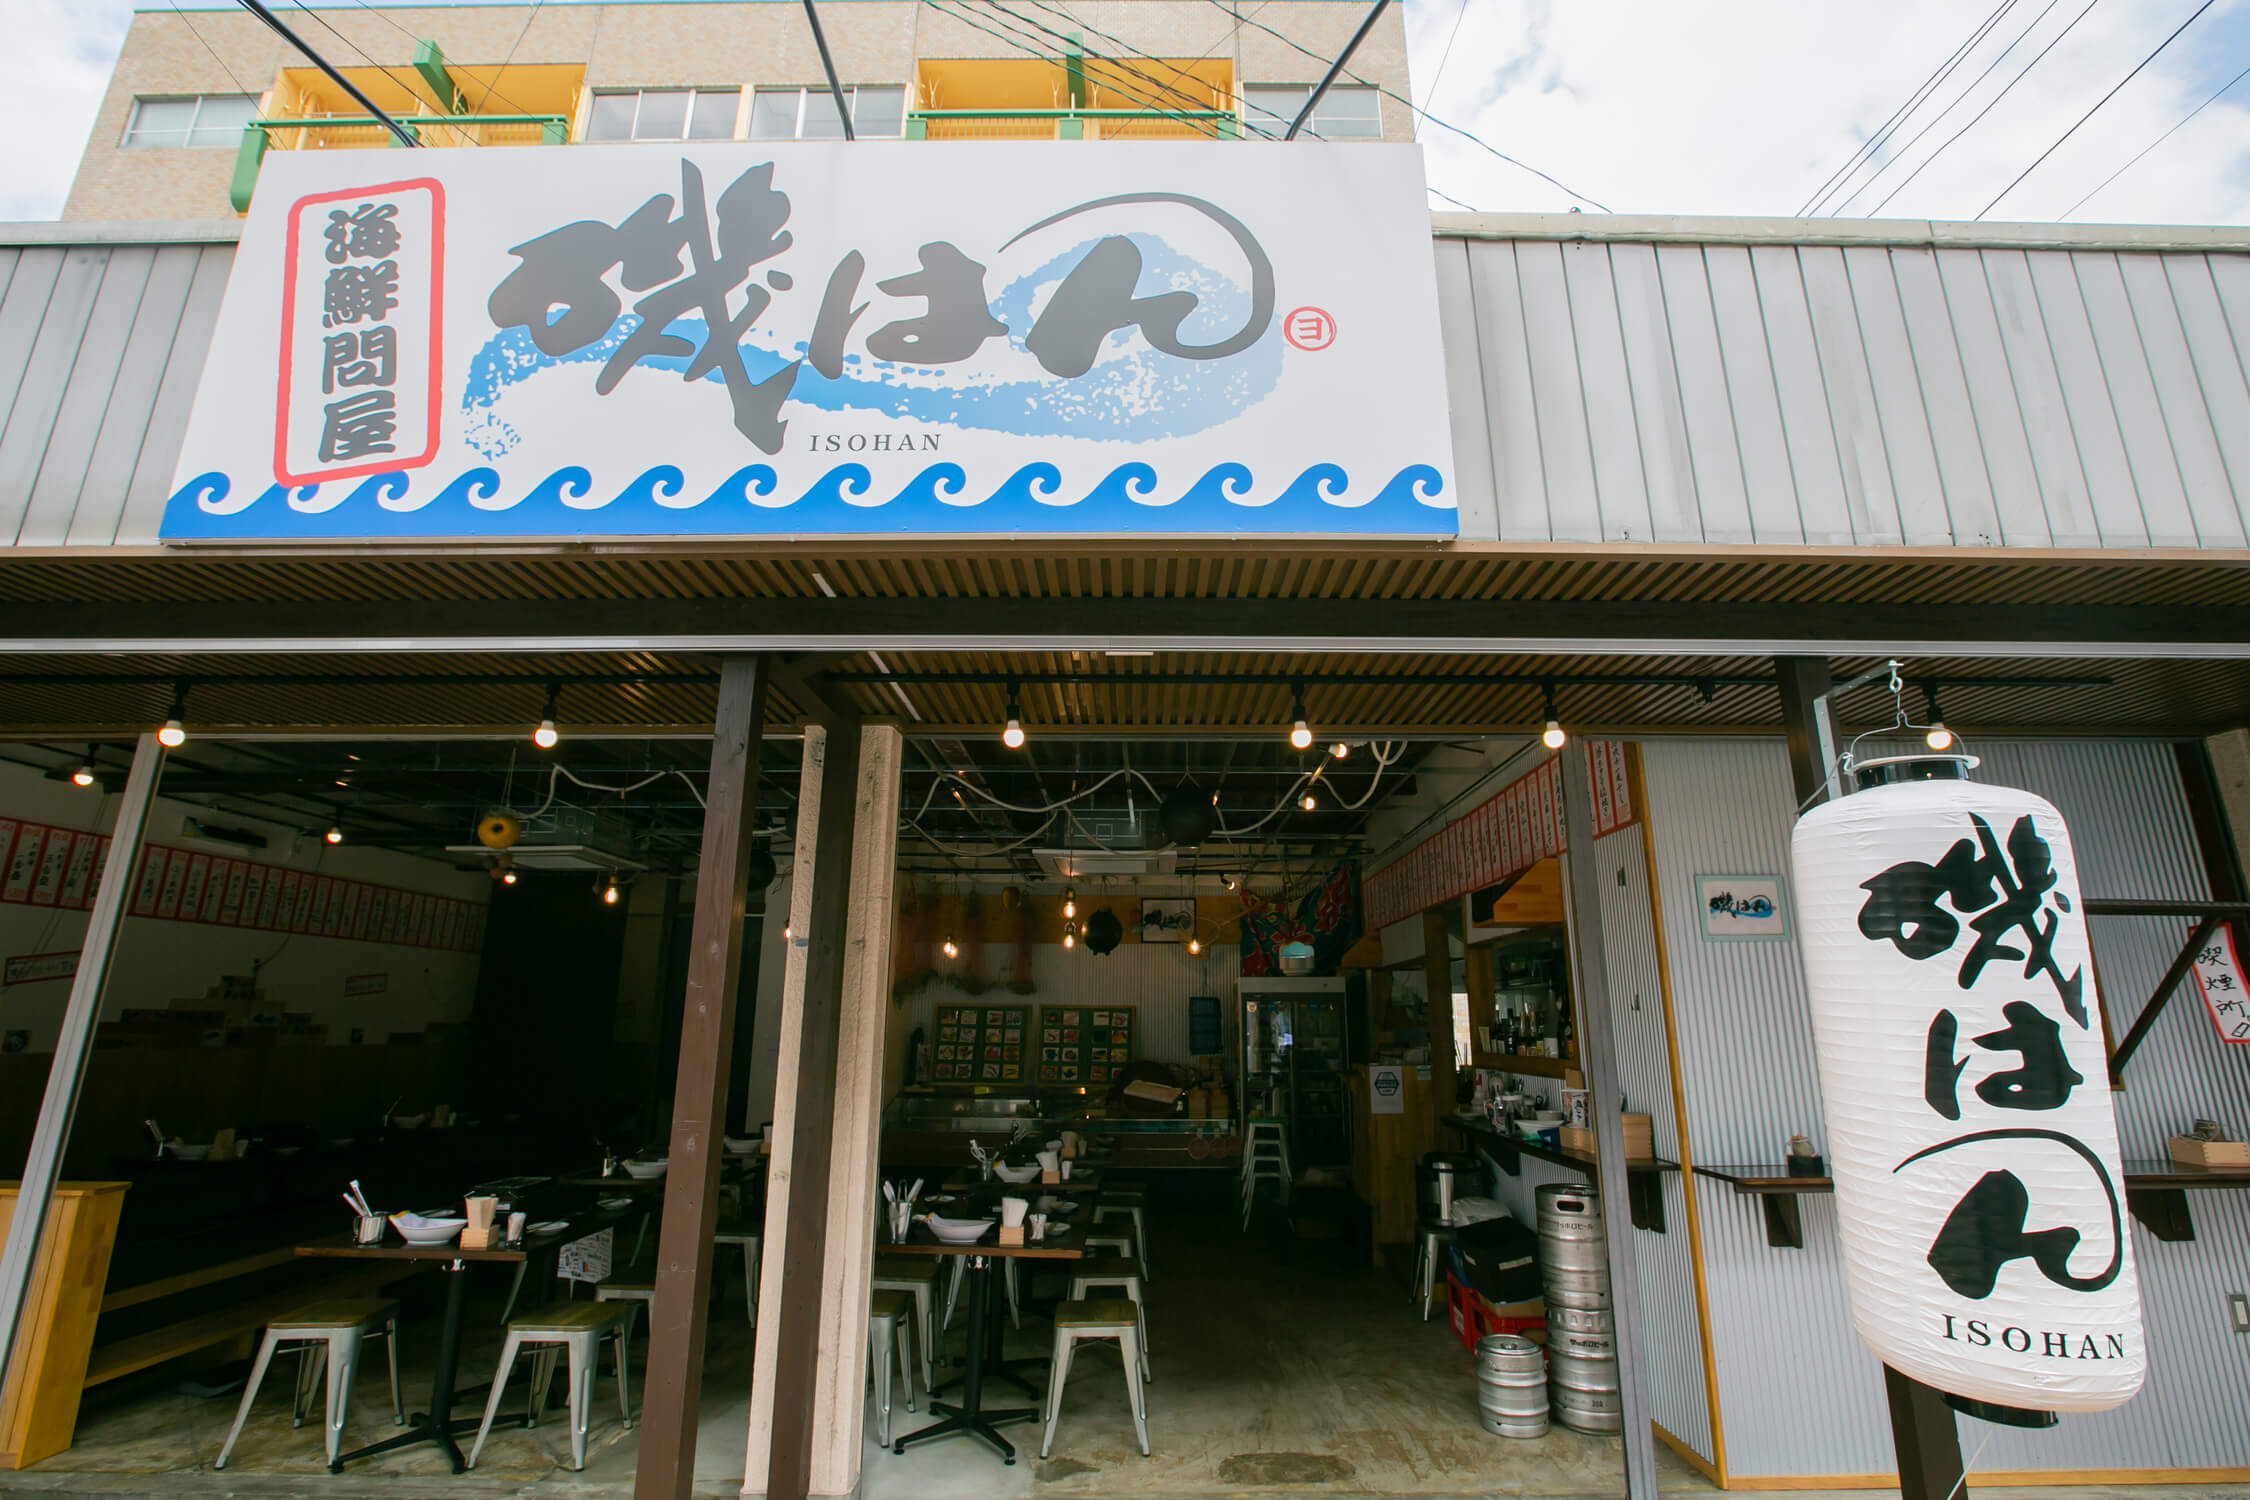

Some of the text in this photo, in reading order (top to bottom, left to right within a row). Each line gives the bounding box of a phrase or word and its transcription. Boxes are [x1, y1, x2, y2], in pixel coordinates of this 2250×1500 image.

[318, 202, 402, 463] 海鮮問屋
[487, 157, 1275, 456] 磯はん
[809, 433, 943, 452] ISOHAN
[1857, 811, 2123, 1300] 磯はん
[2197, 945, 2246, 1019] 喫煙所
[1941, 1314, 2126, 1361] ISOHAN
